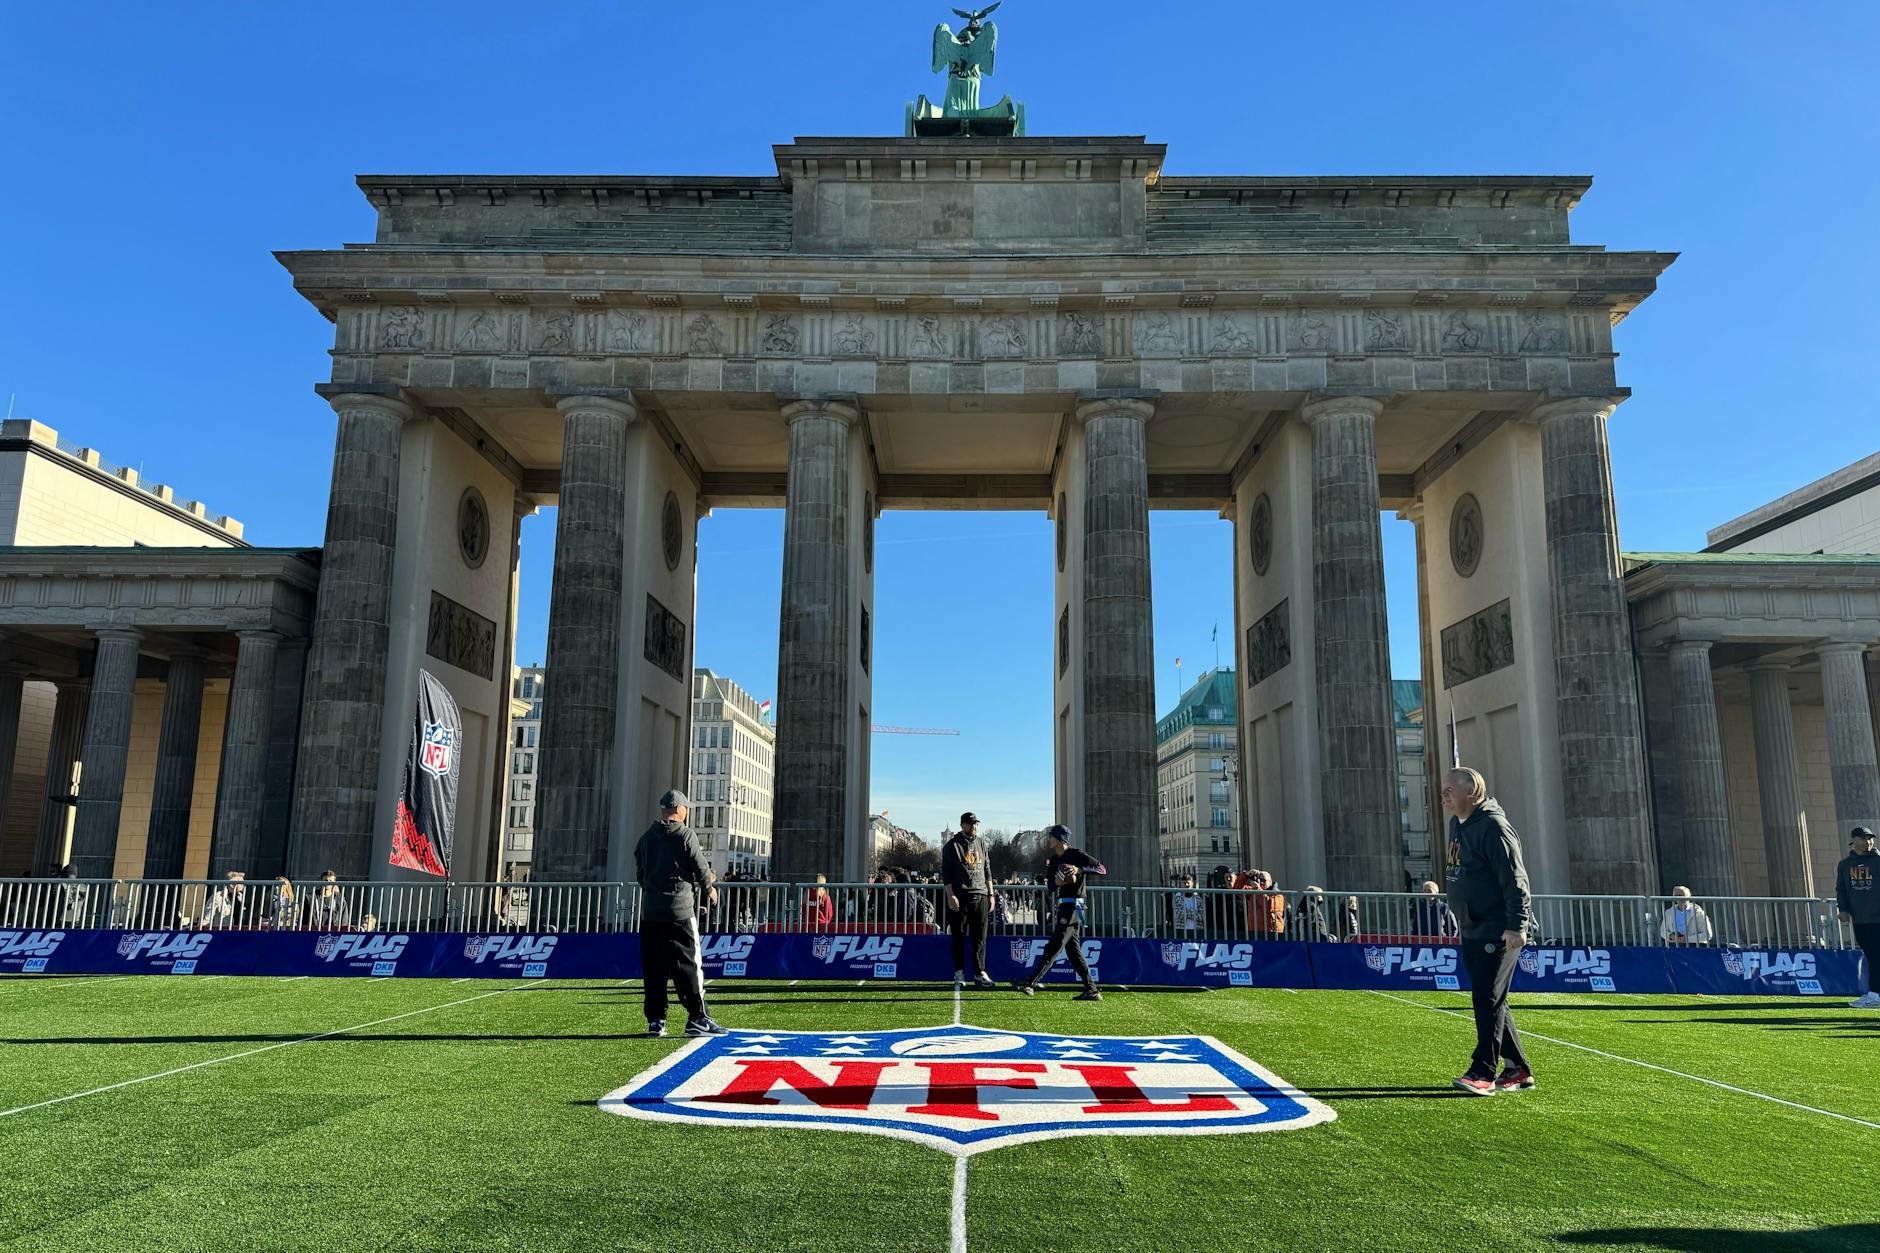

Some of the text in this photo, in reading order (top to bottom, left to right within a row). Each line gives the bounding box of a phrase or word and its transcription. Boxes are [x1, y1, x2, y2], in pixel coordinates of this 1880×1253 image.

[423, 743, 447, 769] NFL
[1849, 867, 1873, 880] NFL
[126, 933, 213, 960] FLAG
[325, 934, 410, 962] FLAG
[475, 936, 559, 964] FLAG
[700, 935, 756, 959] LAG
[825, 936, 904, 964] FLAG
[1177, 942, 1253, 971] FLAG
[175, 961, 195, 969] DKB
[525, 964, 545, 972] DKB
[1383, 947, 1457, 975] FLAG
[1537, 949, 1610, 978] FLAG
[1742, 952, 1817, 980] FLAG
[1231, 972, 1250, 980] DKB
[1592, 978, 1612, 986] DKB
[1799, 981, 1820, 989] DKB
[690, 1060, 1241, 1121] NFL
